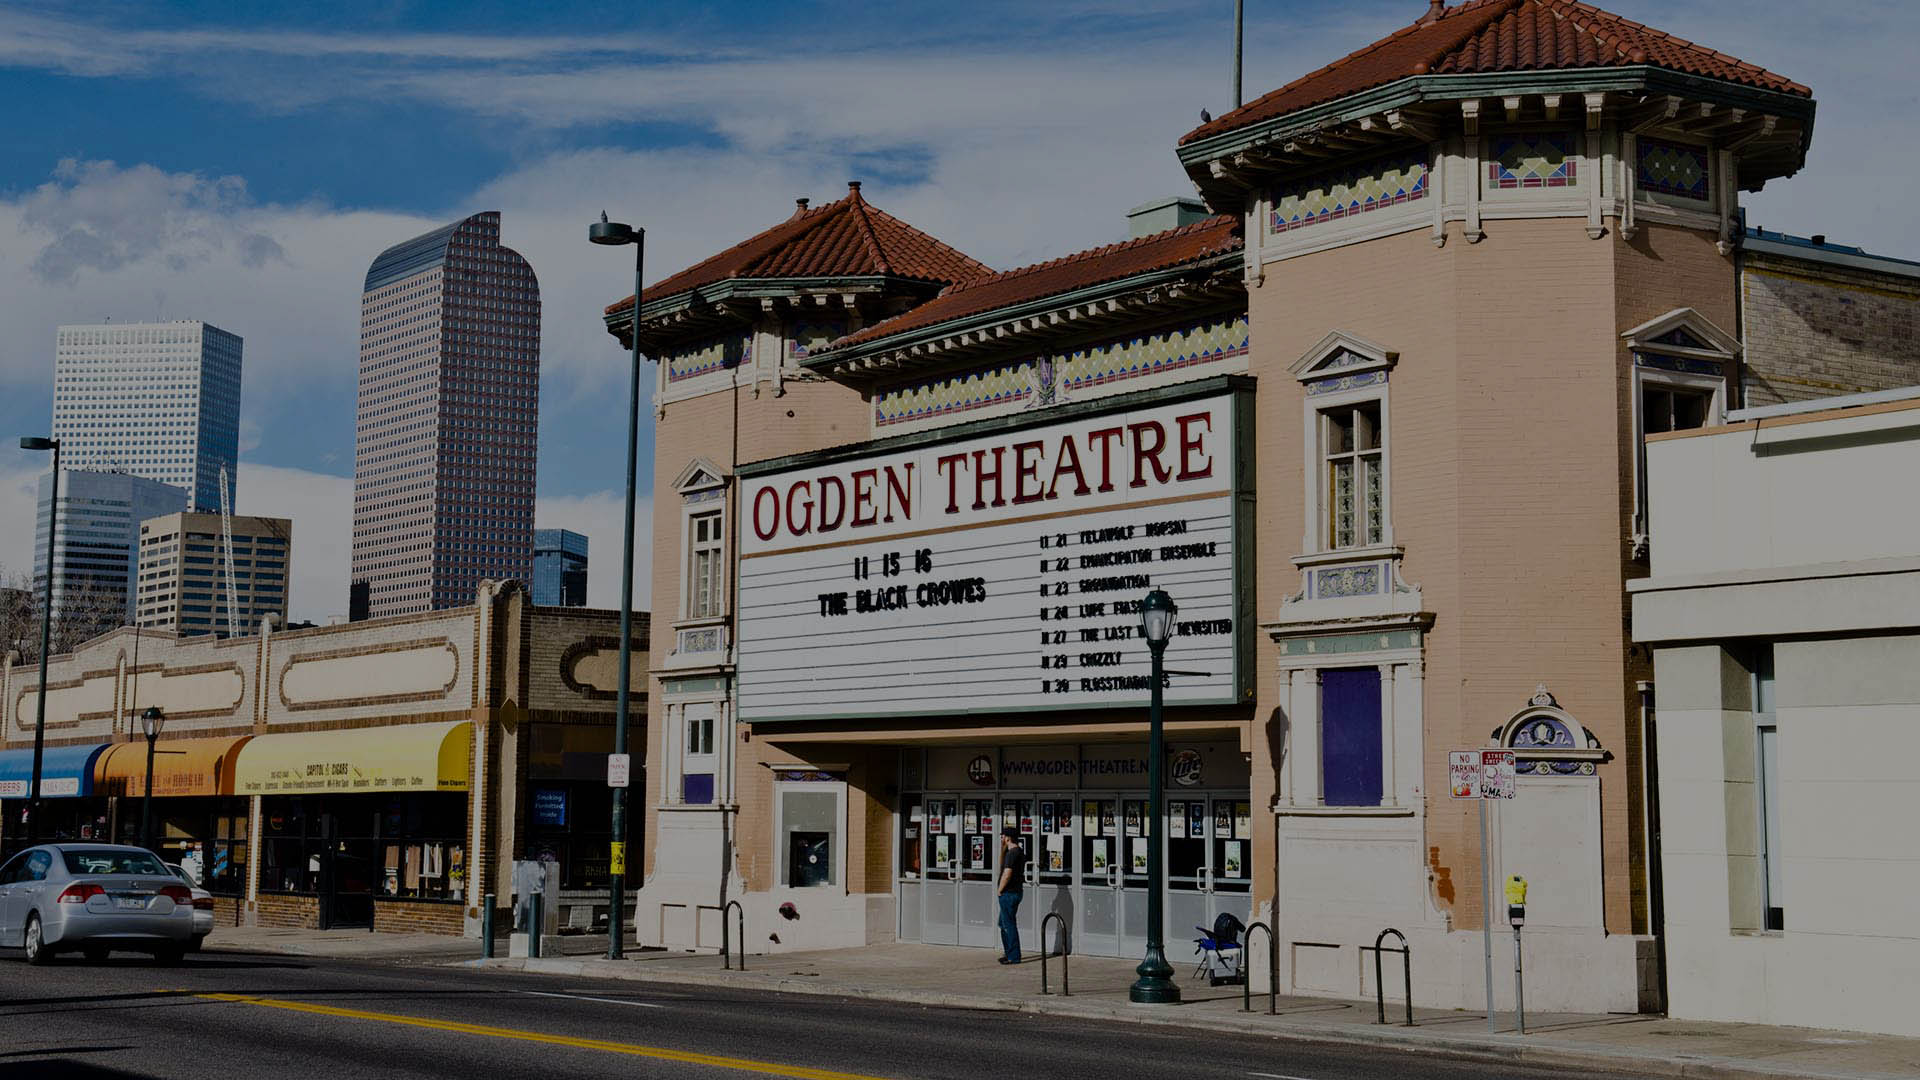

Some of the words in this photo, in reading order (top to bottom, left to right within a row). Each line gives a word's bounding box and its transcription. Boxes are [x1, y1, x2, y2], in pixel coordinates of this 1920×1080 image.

[752, 462, 915, 541] OGDEN
[937, 411, 1213, 515] THEATRE
[854, 556, 868, 580] 11
[882, 552, 900, 577] 15
[915, 548, 932, 574] 16
[1055, 557, 1069, 571] 22
[1055, 580, 1069, 596] 23
[818, 591, 848, 617] THE
[855, 584, 908, 614] BLACK
[916, 577, 986, 608] CROWES
[1053, 630, 1067, 644] 27
[1079, 627, 1099, 642] THE
[1104, 625, 1132, 640] LAST
[1459, 754, 1471, 763] NO
[1451, 764, 1480, 774] PARKING
[536, 794, 563, 802] Smoking
